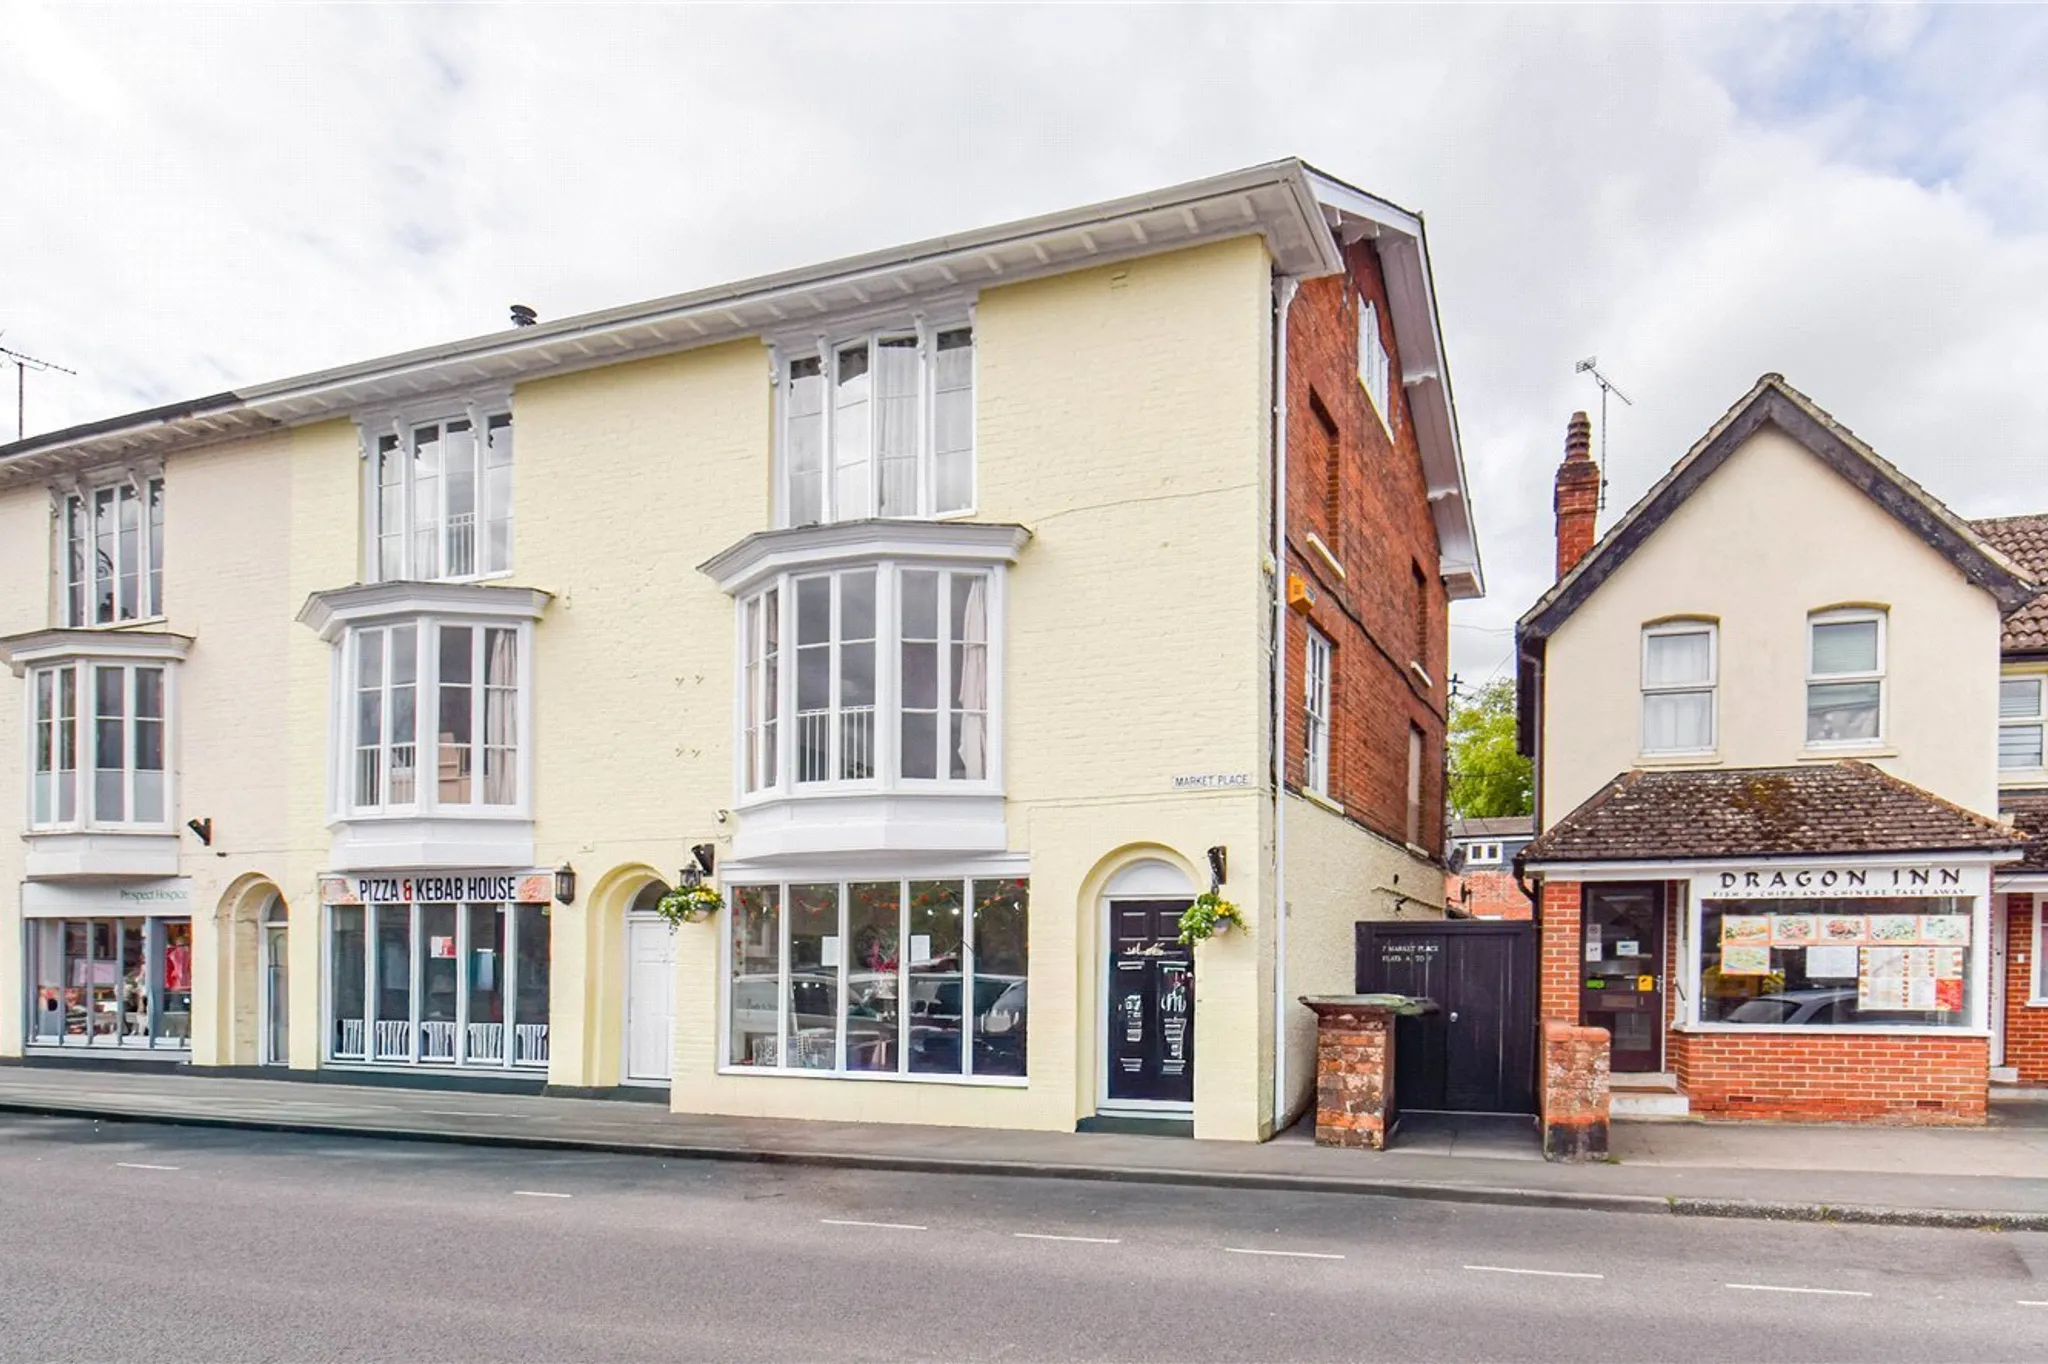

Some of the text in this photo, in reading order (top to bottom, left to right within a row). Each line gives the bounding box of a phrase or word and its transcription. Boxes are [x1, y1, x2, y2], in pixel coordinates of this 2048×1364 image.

[1174, 774, 1249, 787] MARKET PLACE
[1720, 868, 1960, 888] DRAGON INN
[359, 876, 516, 901] PIZZA & KEBAB HOUSE
[1833, 889, 1886, 897] CHINESE
[1894, 888, 1924, 896] TAKE
[1932, 888, 1967, 896] AWAY
